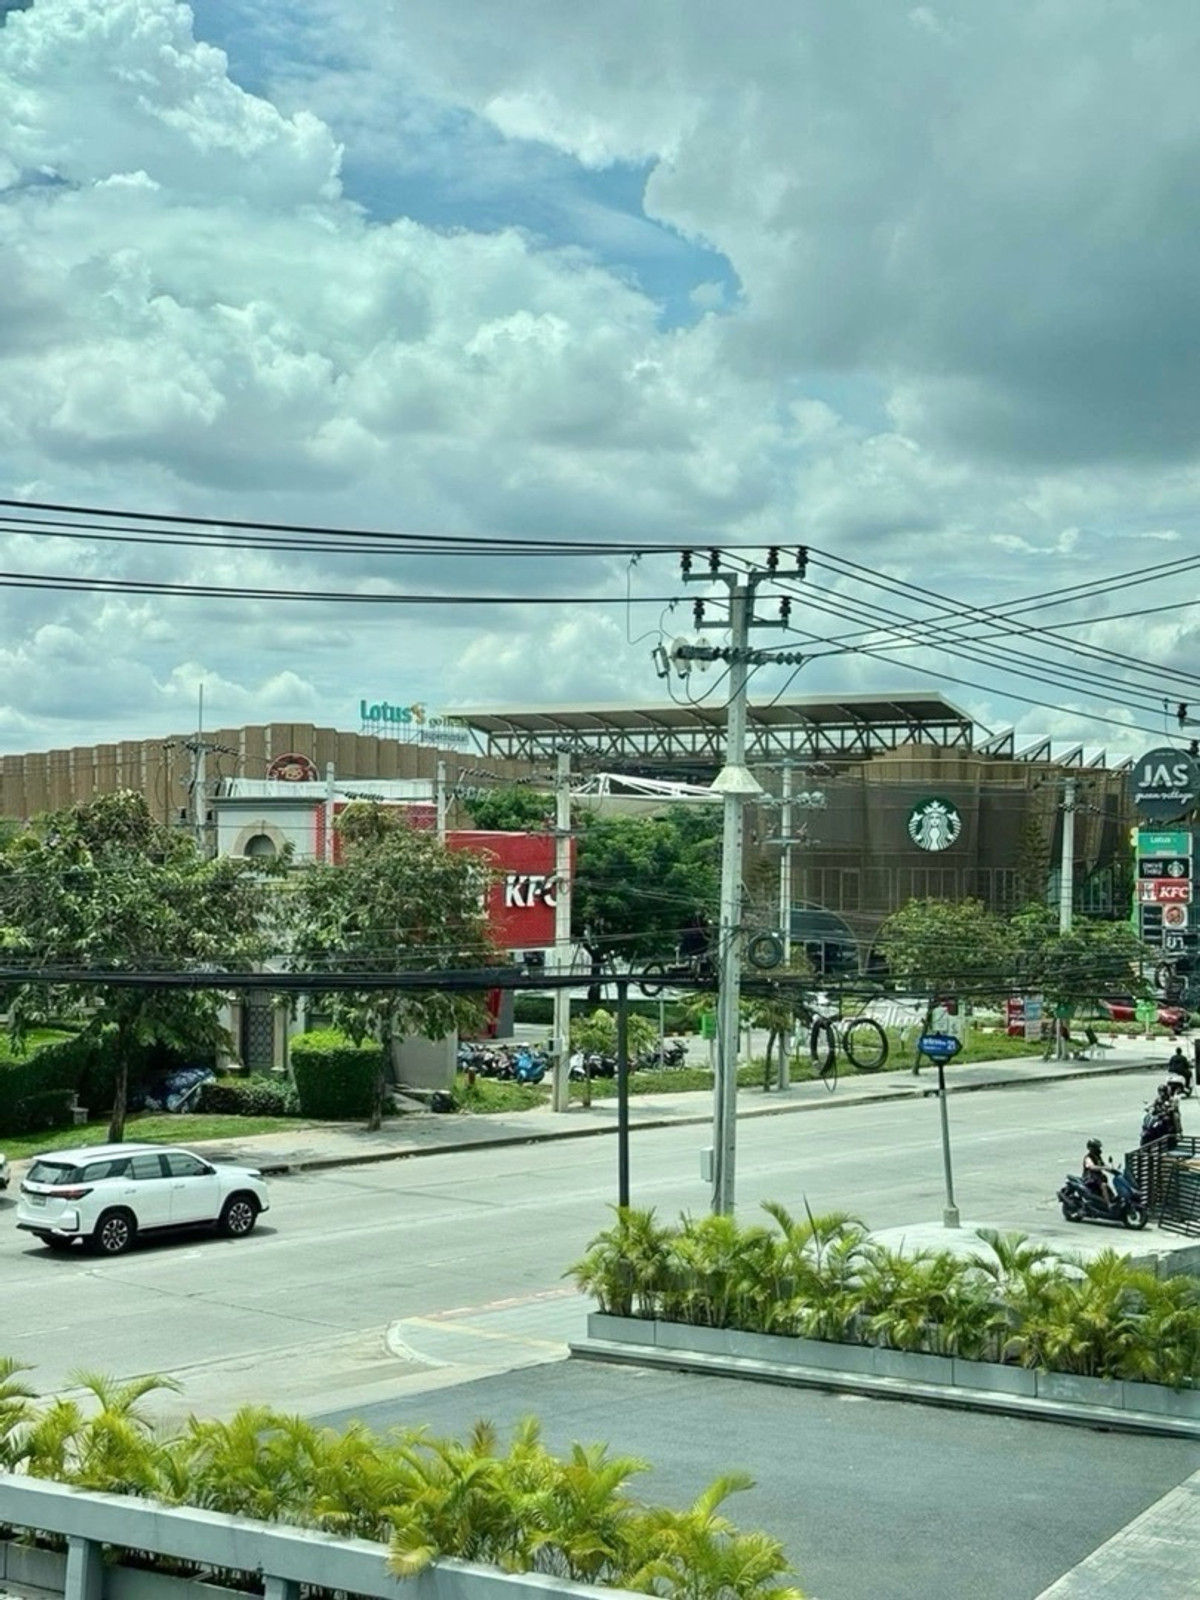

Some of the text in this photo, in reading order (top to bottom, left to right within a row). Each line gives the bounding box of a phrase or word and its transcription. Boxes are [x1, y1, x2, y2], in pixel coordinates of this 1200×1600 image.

[1138, 763, 1188, 787] JAS
[1135, 789, 1194, 804] green village
[1159, 886, 1189, 898] KFC
